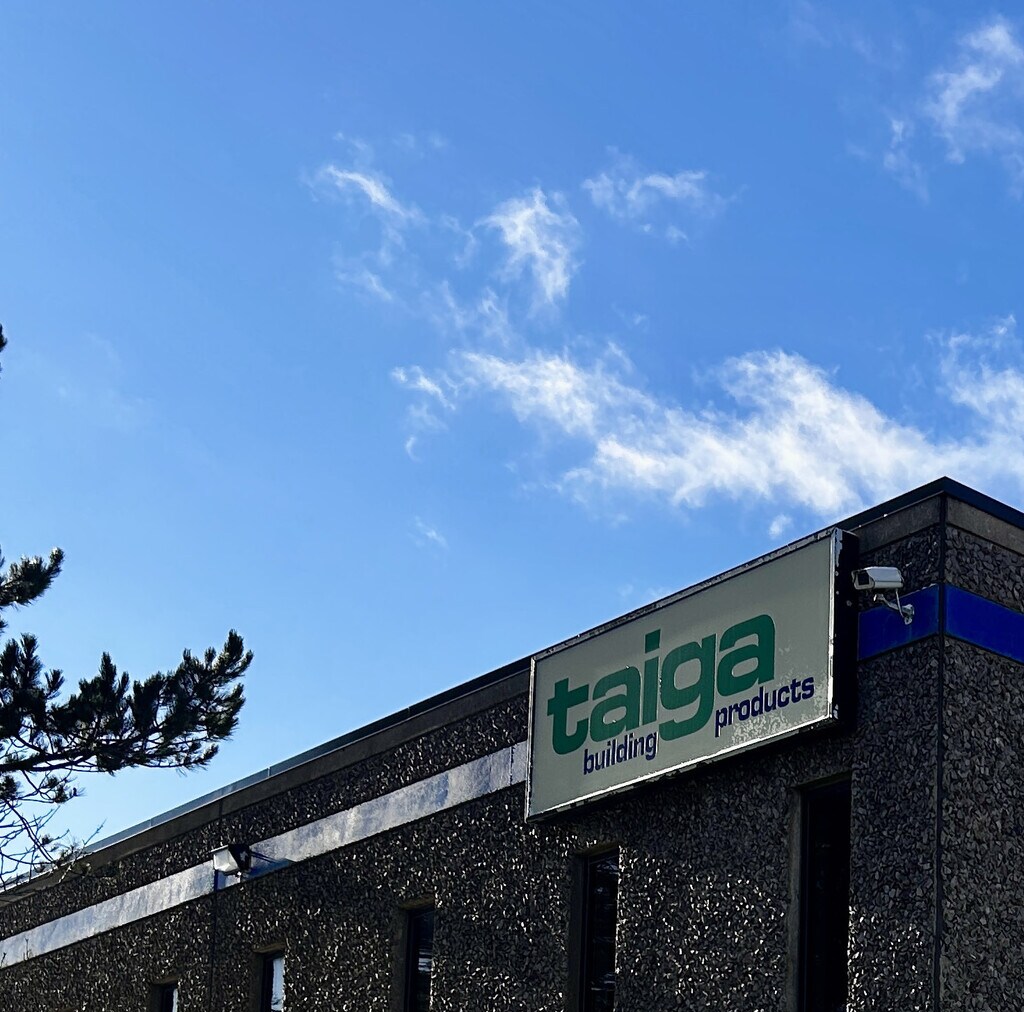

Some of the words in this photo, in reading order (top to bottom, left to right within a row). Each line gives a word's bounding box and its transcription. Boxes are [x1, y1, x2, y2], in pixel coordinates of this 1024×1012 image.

[547, 614, 775, 755] taiga
[583, 731, 659, 775] building
[715, 676, 815, 738] products
